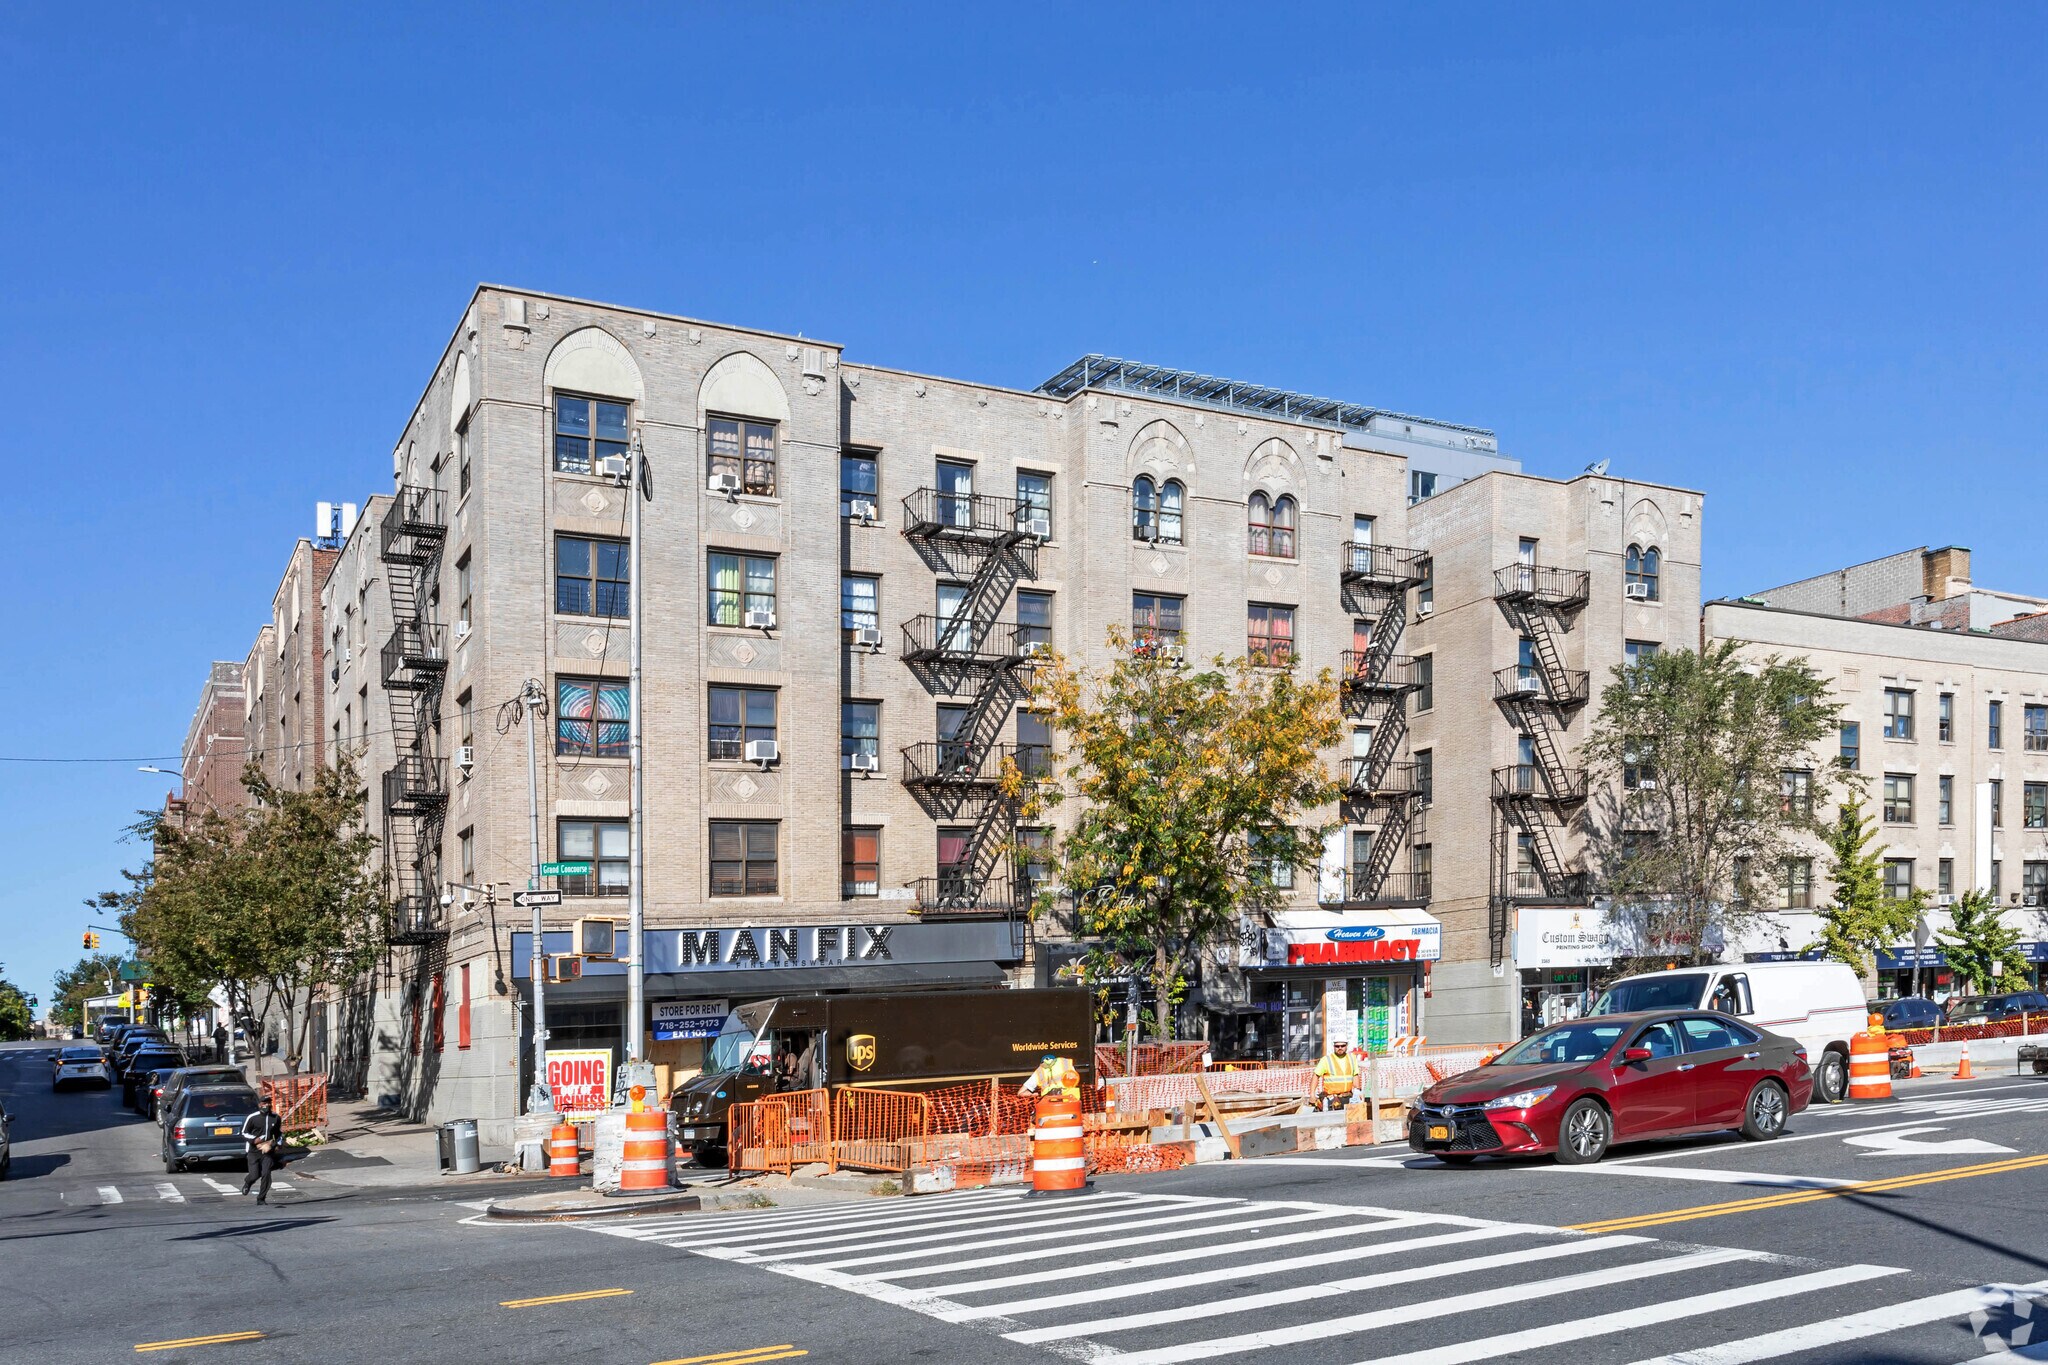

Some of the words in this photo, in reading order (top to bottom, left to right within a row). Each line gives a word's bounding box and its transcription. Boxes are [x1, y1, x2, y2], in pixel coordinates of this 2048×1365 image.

[543, 865, 559, 874] Grand
[561, 865, 588, 874] Concourse
[1333, 928, 1361, 938] Heaven
[1362, 928, 1380, 938] Aid
[1411, 926, 1439, 935] FARMACIA
[1542, 931, 1575, 944] Custom
[1578, 931, 1609, 945] Swagg
[1288, 939, 1421, 965] PHARMACY
[736, 961, 765, 969] FINE
[774, 959, 842, 968] MENSWEAR
[660, 1006, 684, 1017] STORE
[685, 1005, 700, 1015] FOR
[702, 1004, 721, 1015] RENT
[659, 1019, 719, 1031] 718-252-9173
[672, 1030, 689, 1039] EXT
[691, 1029, 707, 1037] 103
[1012, 1042, 1049, 1052] Worldwide
[1049, 1041, 1078, 1050] Services
[850, 1045, 873, 1066] ups
[548, 1060, 604, 1086] GOING
[553, 1094, 605, 1112] USINESS
